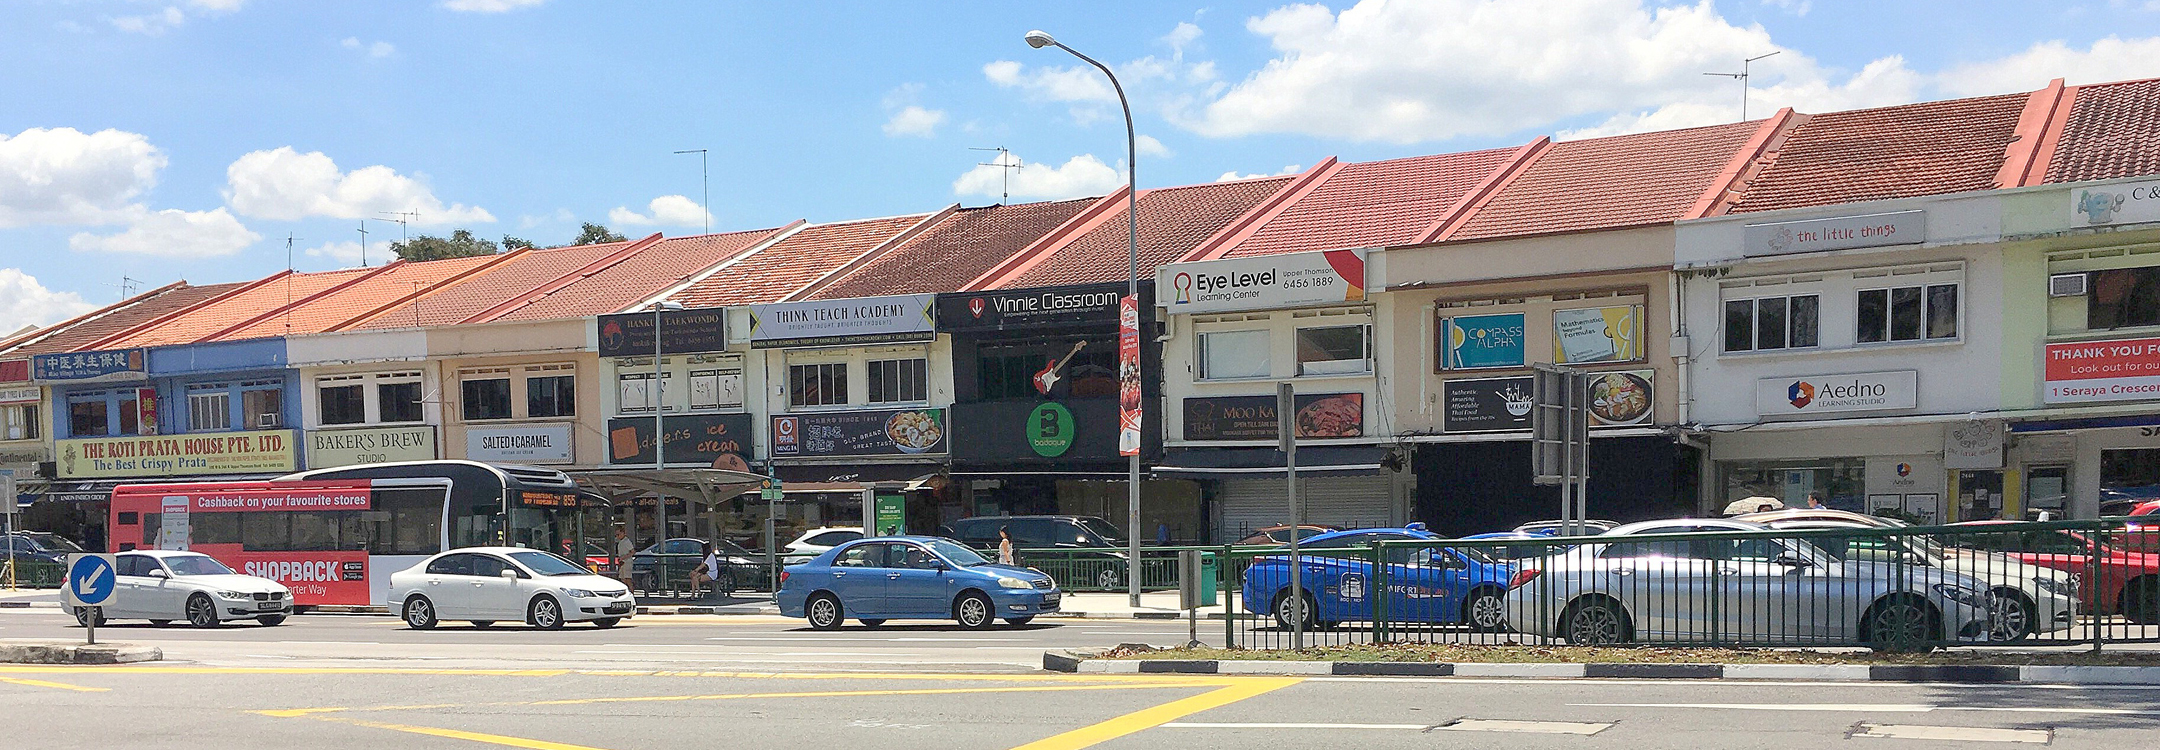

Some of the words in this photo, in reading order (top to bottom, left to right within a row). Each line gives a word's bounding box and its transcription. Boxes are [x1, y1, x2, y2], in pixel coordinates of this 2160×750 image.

[2132, 186, 2145, 201] C
[1797, 230, 1817, 242] the
[1823, 226, 1854, 240] little
[1860, 224, 1896, 237] things
[1282, 270, 1303, 278] Upper
[1304, 267, 1334, 275] Thomson
[1197, 273, 1228, 294] Eye
[1231, 267, 1276, 288] Level
[1283, 278, 1309, 289] 6456
[1312, 275, 1334, 287] 1889
[993, 296, 1038, 313] Vinnie
[1042, 291, 1118, 310] Classroom
[1197, 292, 1231, 302] Learning
[1232, 289, 1260, 299] Center
[666, 314, 719, 326] TAEKWONDO
[775, 308, 809, 324] THINK
[814, 306, 848, 321] TEACH
[853, 303, 906, 319] ACADEMY
[1560, 317, 1605, 328] Mathematics
[1467, 325, 1523, 340] COMPASS
[1564, 328, 1596, 339] Formulas
[1476, 337, 1517, 349] ALPHA
[2052, 346, 2106, 361] THANK
[2110, 344, 2143, 357] YOU
[2070, 364, 2099, 374] Look
[2102, 363, 2122, 373] out
[2125, 362, 2141, 371] for
[1819, 379, 1886, 399] Aedno
[2052, 387, 2059, 397] 1
[2062, 386, 2107, 397] Seraya
[1818, 399, 1856, 408] LEARNING
[1856, 397, 1886, 407] STUDIO
[1223, 407, 1256, 419] MOO
[706, 424, 727, 435] ice
[315, 433, 376, 451] BAKER'S
[381, 430, 426, 450] BREW
[482, 436, 510, 449] SALTED
[515, 434, 552, 449] CARAMEL
[697, 440, 740, 452] cream
[843, 436, 857, 446] OLD
[852, 441, 873, 450] GREAT
[82, 442, 104, 459] THE
[108, 441, 135, 458] ROTI
[139, 439, 180, 457] PRATA
[184, 437, 224, 456] HOUSE
[93, 459, 112, 471] The
[115, 457, 137, 470] Best
[141, 457, 173, 472] Crispy
[178, 457, 207, 469] Prata
[357, 453, 387, 464] STUDIO
[197, 495, 245, 508] Cashback
[246, 498, 259, 507] on
[261, 497, 284, 510] your
[285, 494, 332, 506] favourite
[333, 494, 366, 506] stores
[562, 494, 576, 506] 855
[244, 560, 339, 582] SHOPBACK
[309, 584, 327, 597] Way
